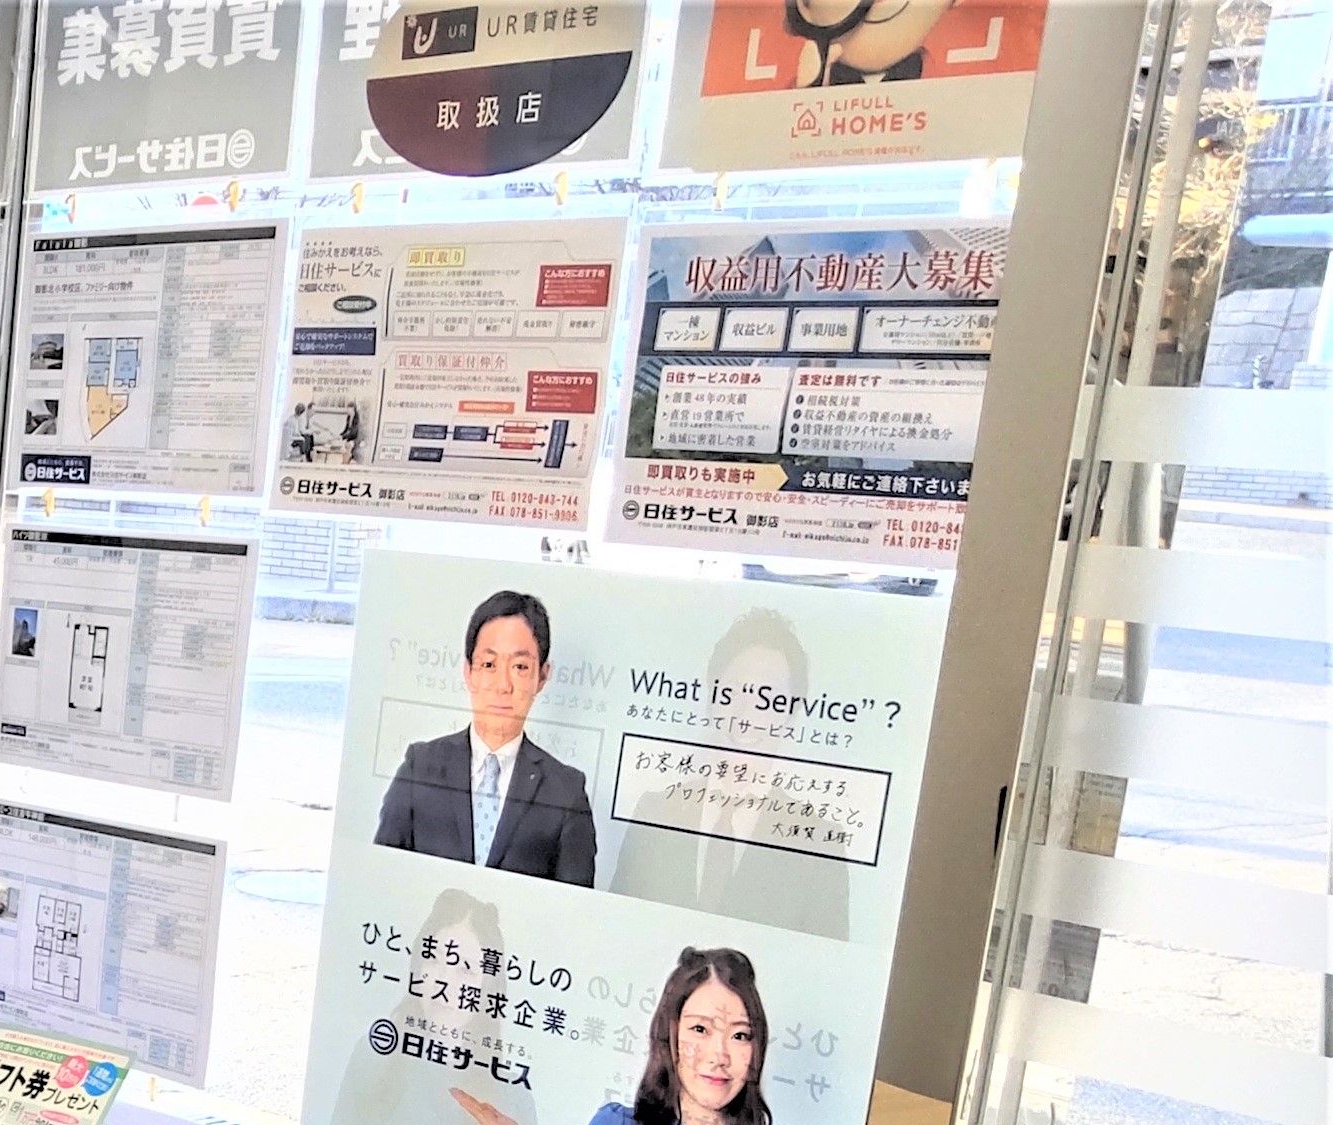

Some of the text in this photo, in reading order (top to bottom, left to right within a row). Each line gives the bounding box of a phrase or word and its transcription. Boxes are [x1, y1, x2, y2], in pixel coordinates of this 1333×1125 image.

[486, 5, 600, 38] UR賃貸住宅
[436, 91, 542, 131] 取扱店
[834, 96, 894, 112] LIFULL
[831, 110, 928, 136] HOME'S
[299, 261, 382, 280] 日住サービスに
[684, 248, 995, 294] 収益用不動産大募集
[732, 322, 777, 337] 収益ビル
[800, 322, 849, 338] 事業用地
[875, 314, 998, 330] オーナーチェンジ不動
[663, 329, 710, 342] マンション
[665, 371, 762, 385] 日住サービスの強み
[798, 373, 882, 388] 査定は無料です
[668, 432, 757, 447] 地域に密着した営業
[36, 465, 86, 482] 日住サービス
[646, 462, 757, 485] 即買取りも実施中
[297, 479, 405, 501] 日住サービス 御影店
[491, 489, 506, 502] TEL
[488, 503, 506, 518] FAX
[642, 503, 739, 525] 日住サービス
[745, 513, 780, 529] 御影店
[886, 517, 904, 530] TEL
[629, 666, 701, 706] What
[712, 676, 733, 705] is
[634, 750, 848, 798] お客様の要望にお応えする
[359, 919, 574, 994] ひと、まち、暮らしの
[357, 958, 581, 1043] サービス探求企業。
[400, 1031, 533, 1090] 日住サービス
[45, 1087, 100, 1116] プレゼント
